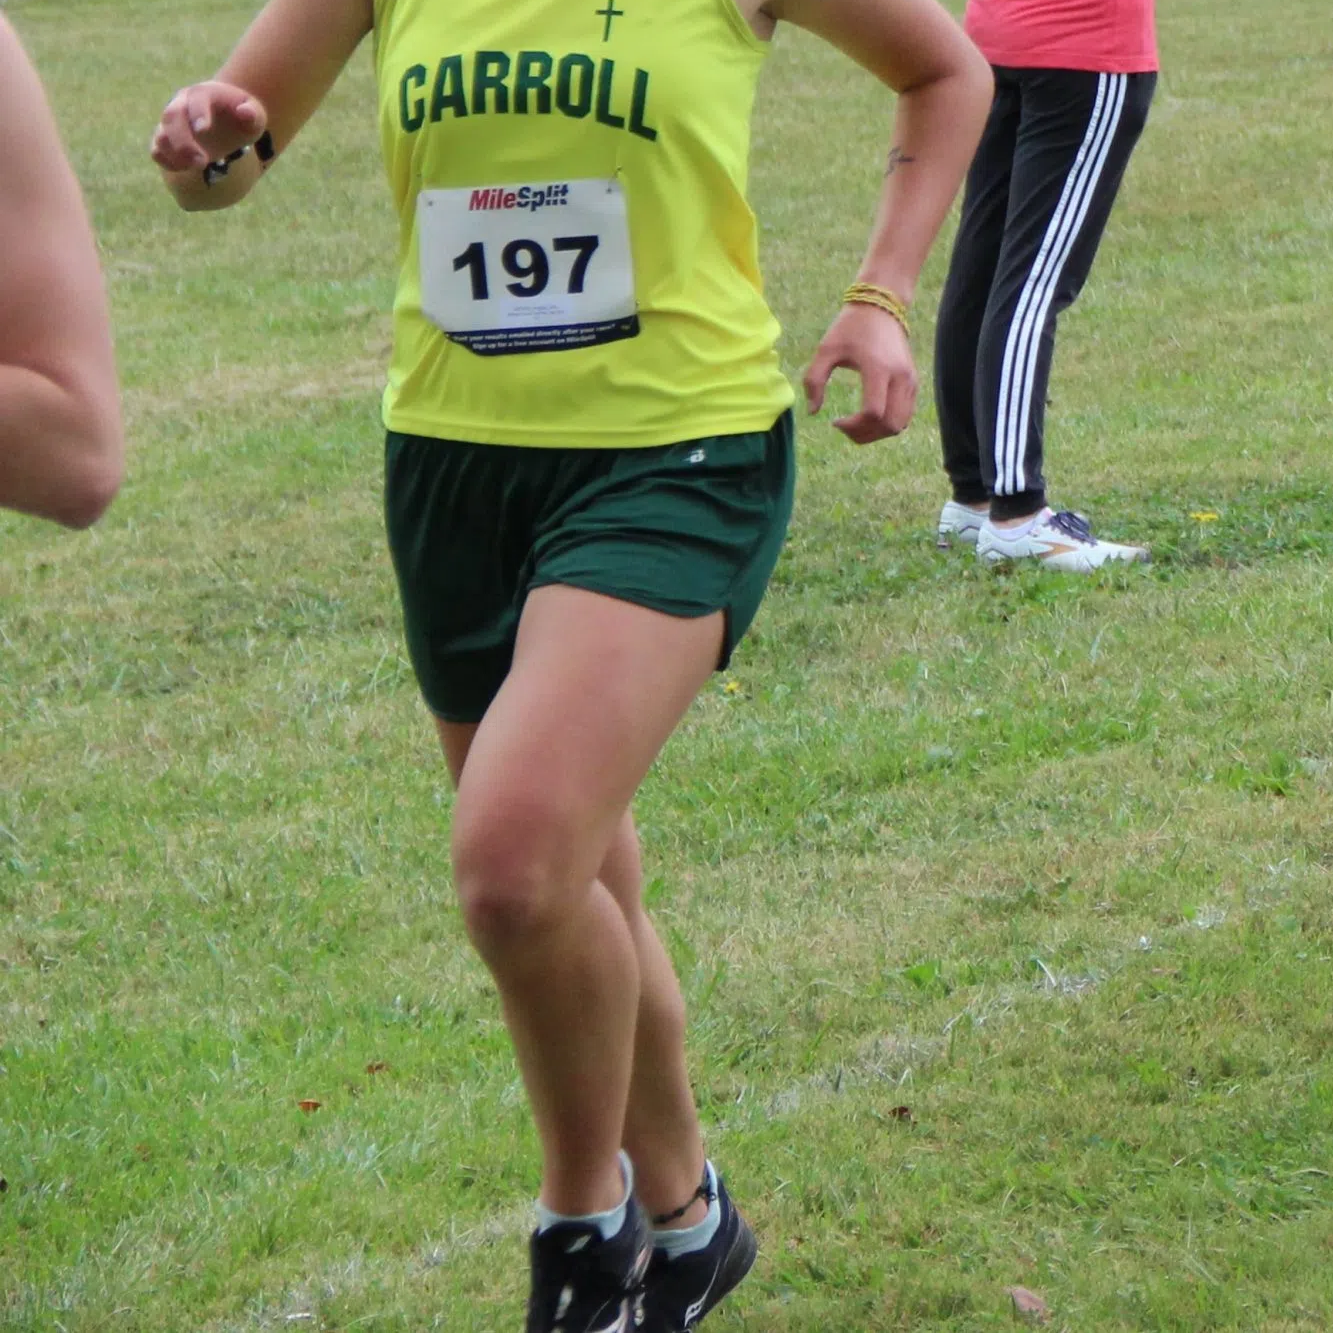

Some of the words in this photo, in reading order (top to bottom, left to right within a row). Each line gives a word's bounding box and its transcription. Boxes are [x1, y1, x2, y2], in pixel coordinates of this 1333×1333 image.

[399, 50, 658, 143] CARROLL
[468, 184, 569, 212] MileSplit
[452, 235, 600, 301] 197
